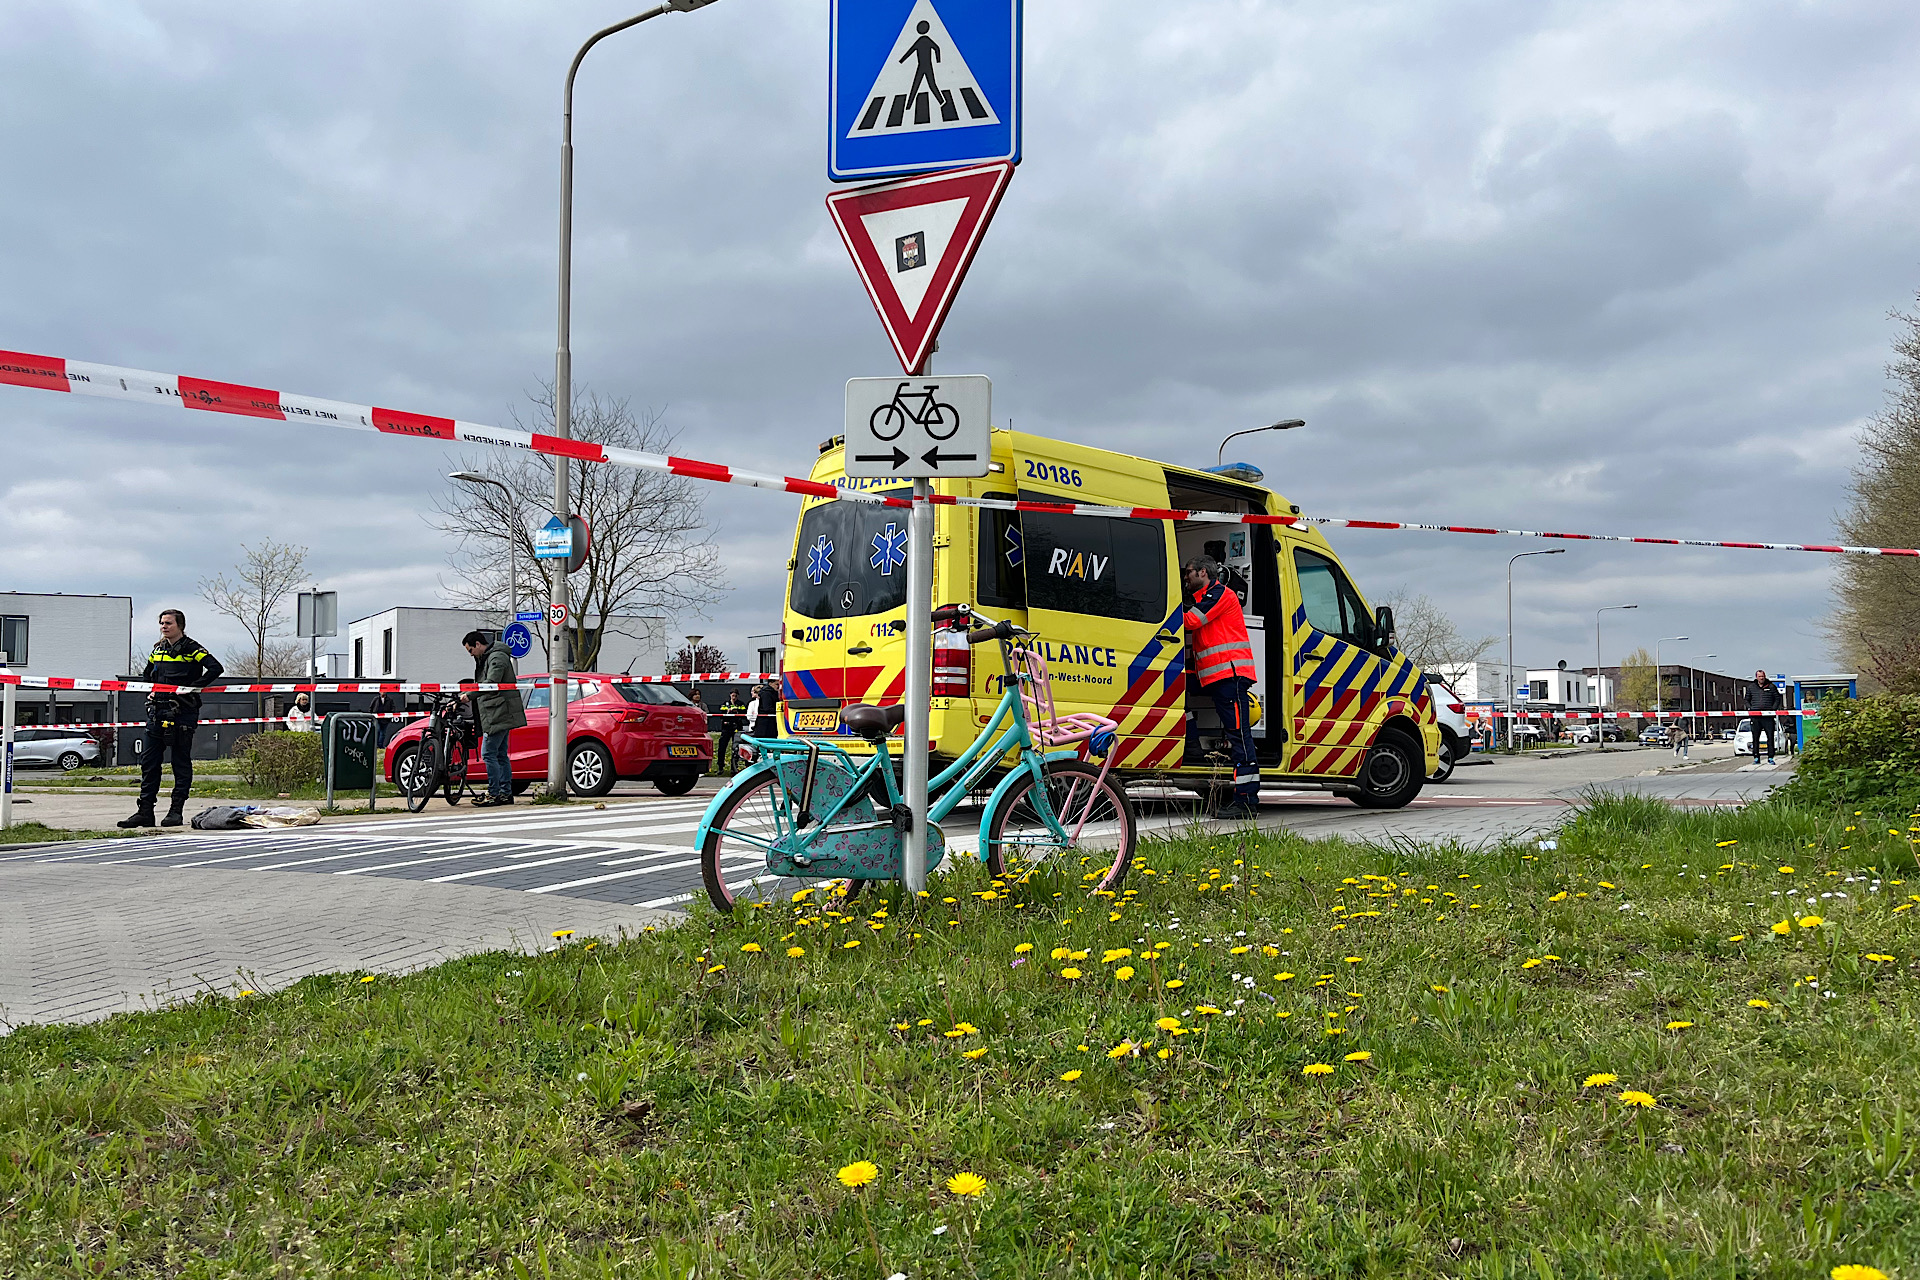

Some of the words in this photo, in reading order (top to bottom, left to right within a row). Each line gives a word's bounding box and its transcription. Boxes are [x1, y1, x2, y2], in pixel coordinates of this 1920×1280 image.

[0, 364, 57, 377] BETRED
[251, 400, 312, 416] BETREDEN
[315, 410, 338, 420] NIET
[1024, 459, 1083, 488] 20186
[551, 609, 564, 619] 30
[805, 623, 843, 643] 20186
[800, 713, 834, 727] PS-246-P
